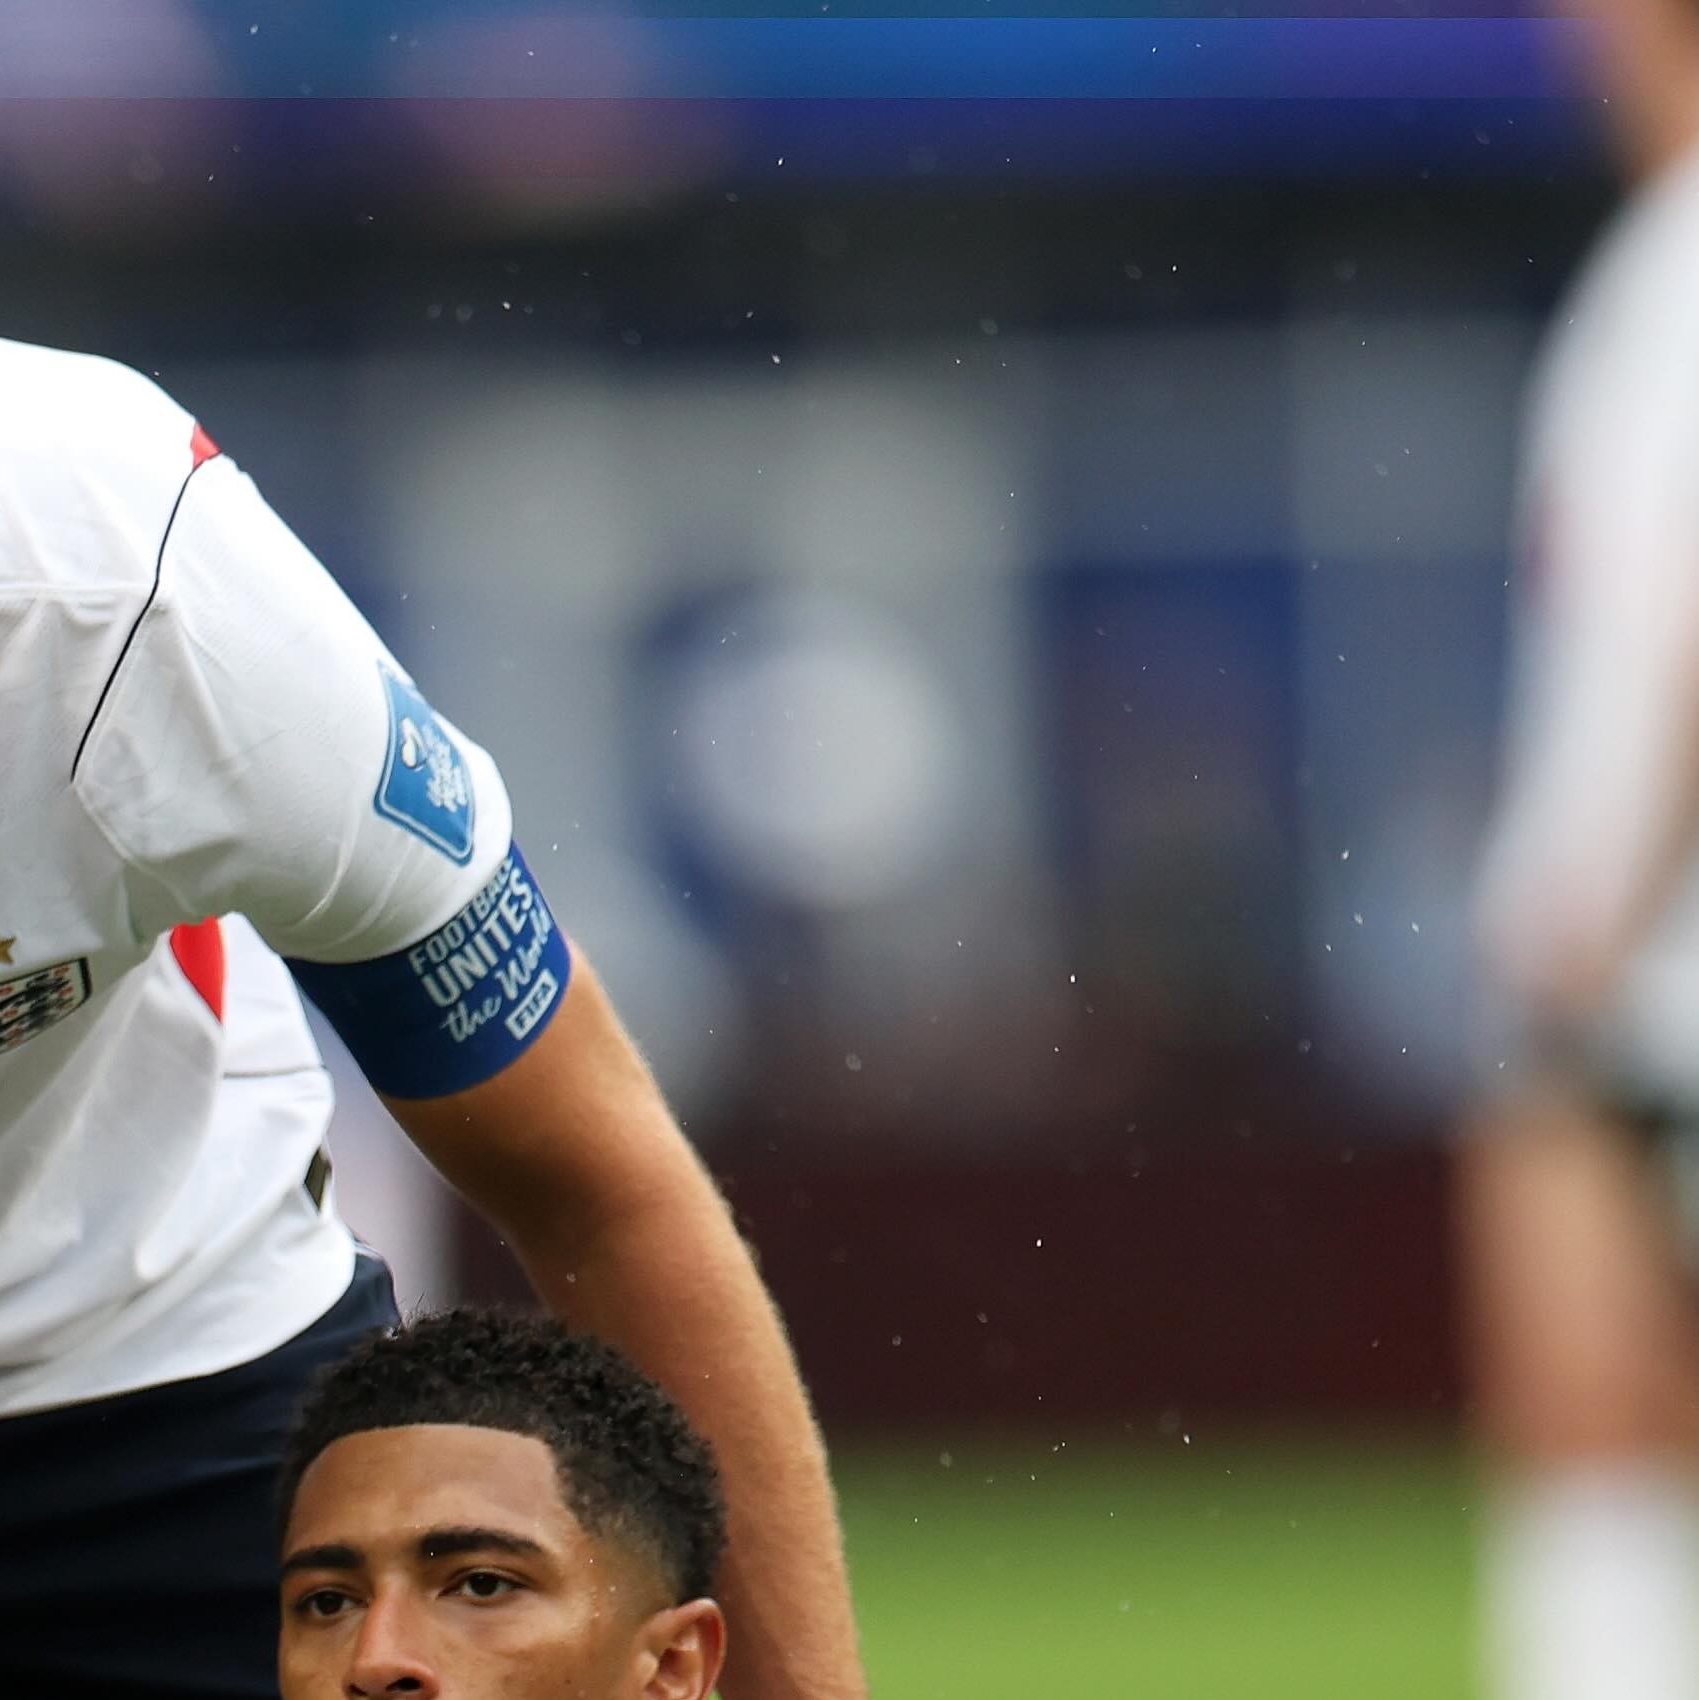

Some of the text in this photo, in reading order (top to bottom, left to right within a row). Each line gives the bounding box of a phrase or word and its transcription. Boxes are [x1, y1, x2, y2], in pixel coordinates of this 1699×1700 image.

[421, 866, 534, 1008] UNITES
[439, 996, 502, 1043] the
[510, 977, 555, 1034] FIFA
